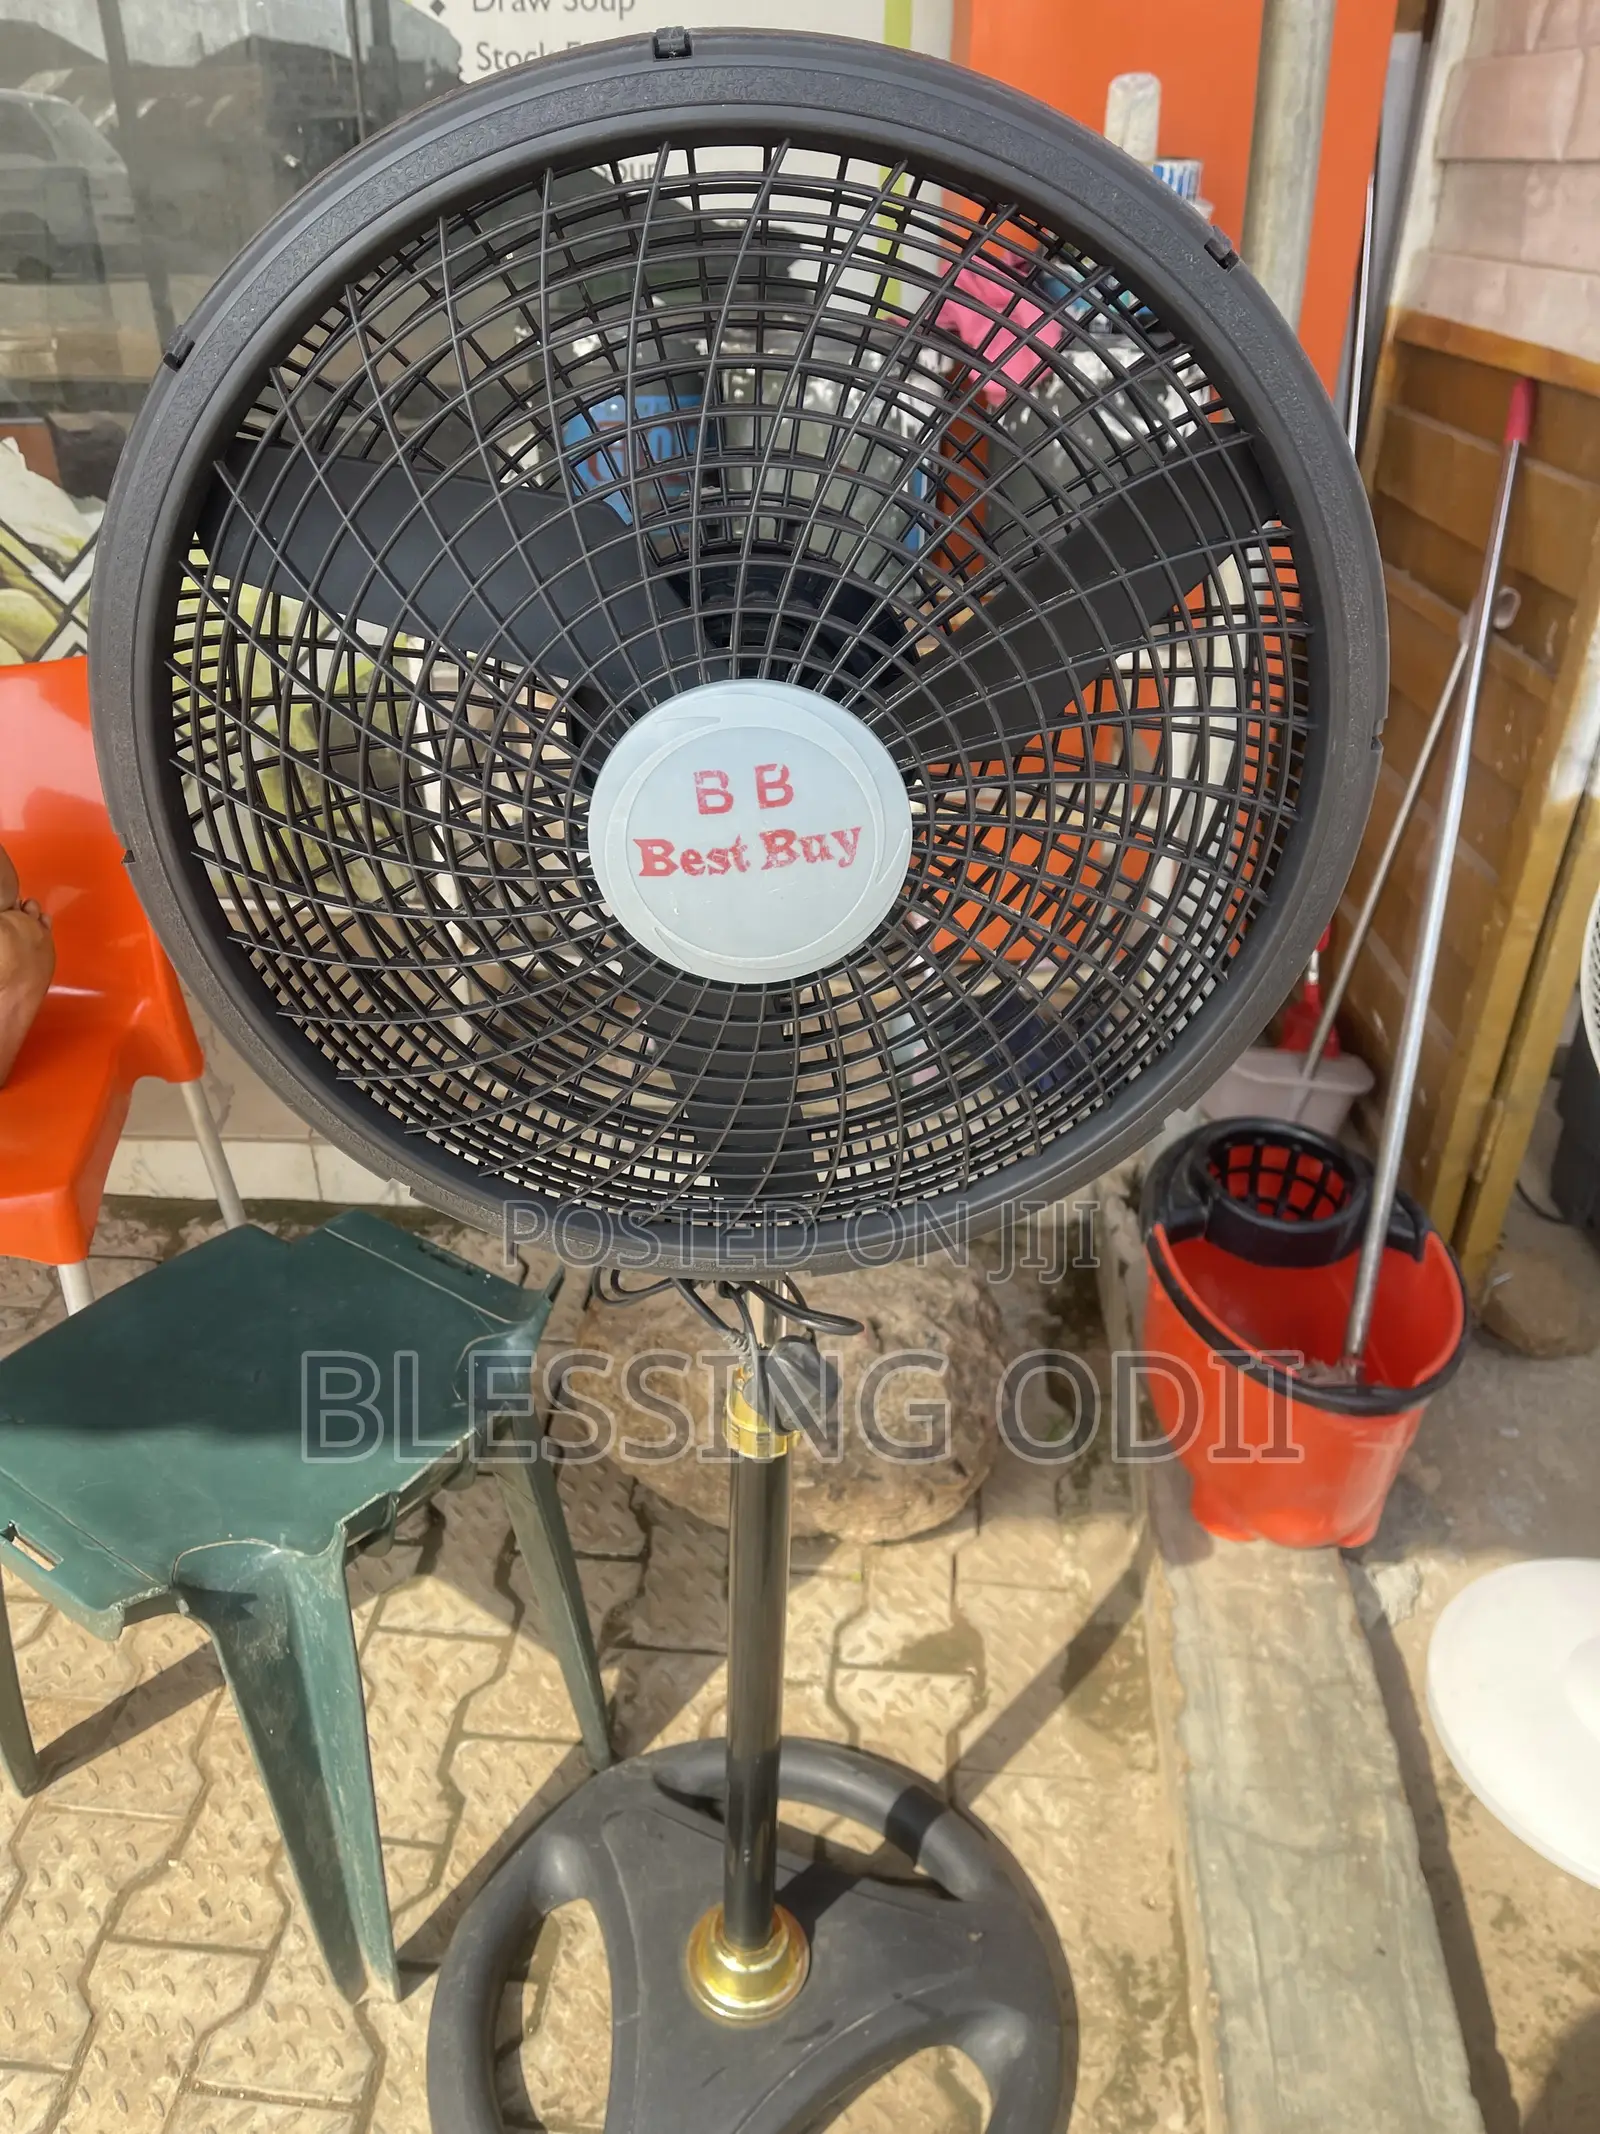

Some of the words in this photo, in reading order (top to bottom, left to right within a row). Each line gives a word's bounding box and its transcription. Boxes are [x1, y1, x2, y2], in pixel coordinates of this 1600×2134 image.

[693, 770, 734, 815] B
[754, 763, 794, 810] B
[633, 835, 751, 877] Best
[759, 826, 863, 871] Buy
